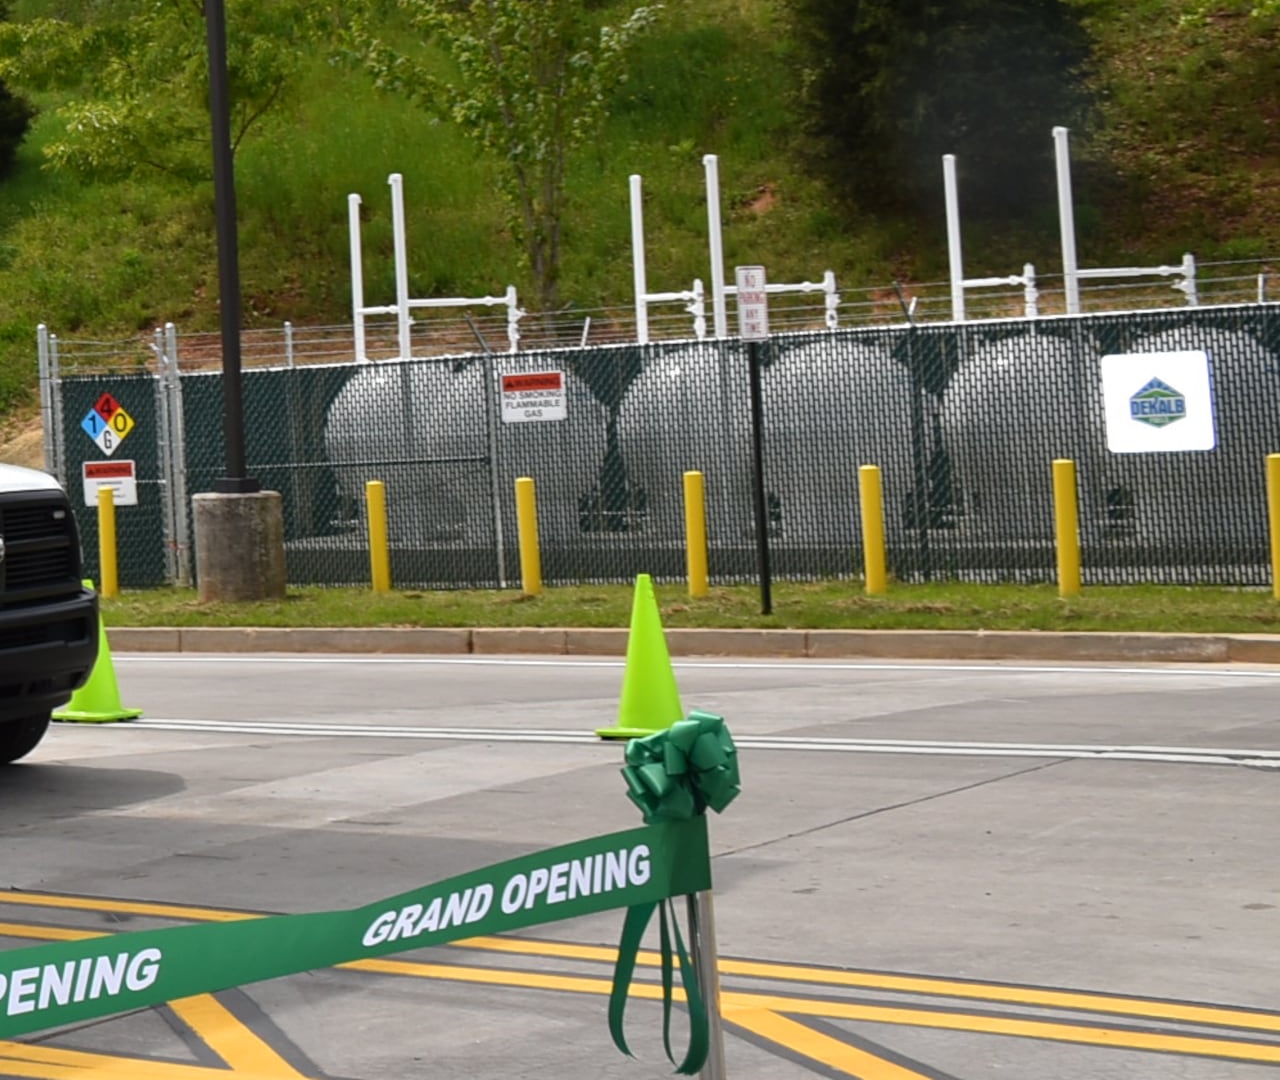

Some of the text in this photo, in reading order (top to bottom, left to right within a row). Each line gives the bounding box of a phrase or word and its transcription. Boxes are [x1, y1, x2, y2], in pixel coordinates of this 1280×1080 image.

[504, 391, 561, 400] NO SMOKING
[100, 398, 114, 413] 4
[505, 400, 561, 409] FLAMMABLE
[1130, 398, 1185, 415] DEKALB
[524, 409, 543, 418] GAS
[88, 414, 97, 434] 1
[362, 845, 650, 946] GRAND OPENING
